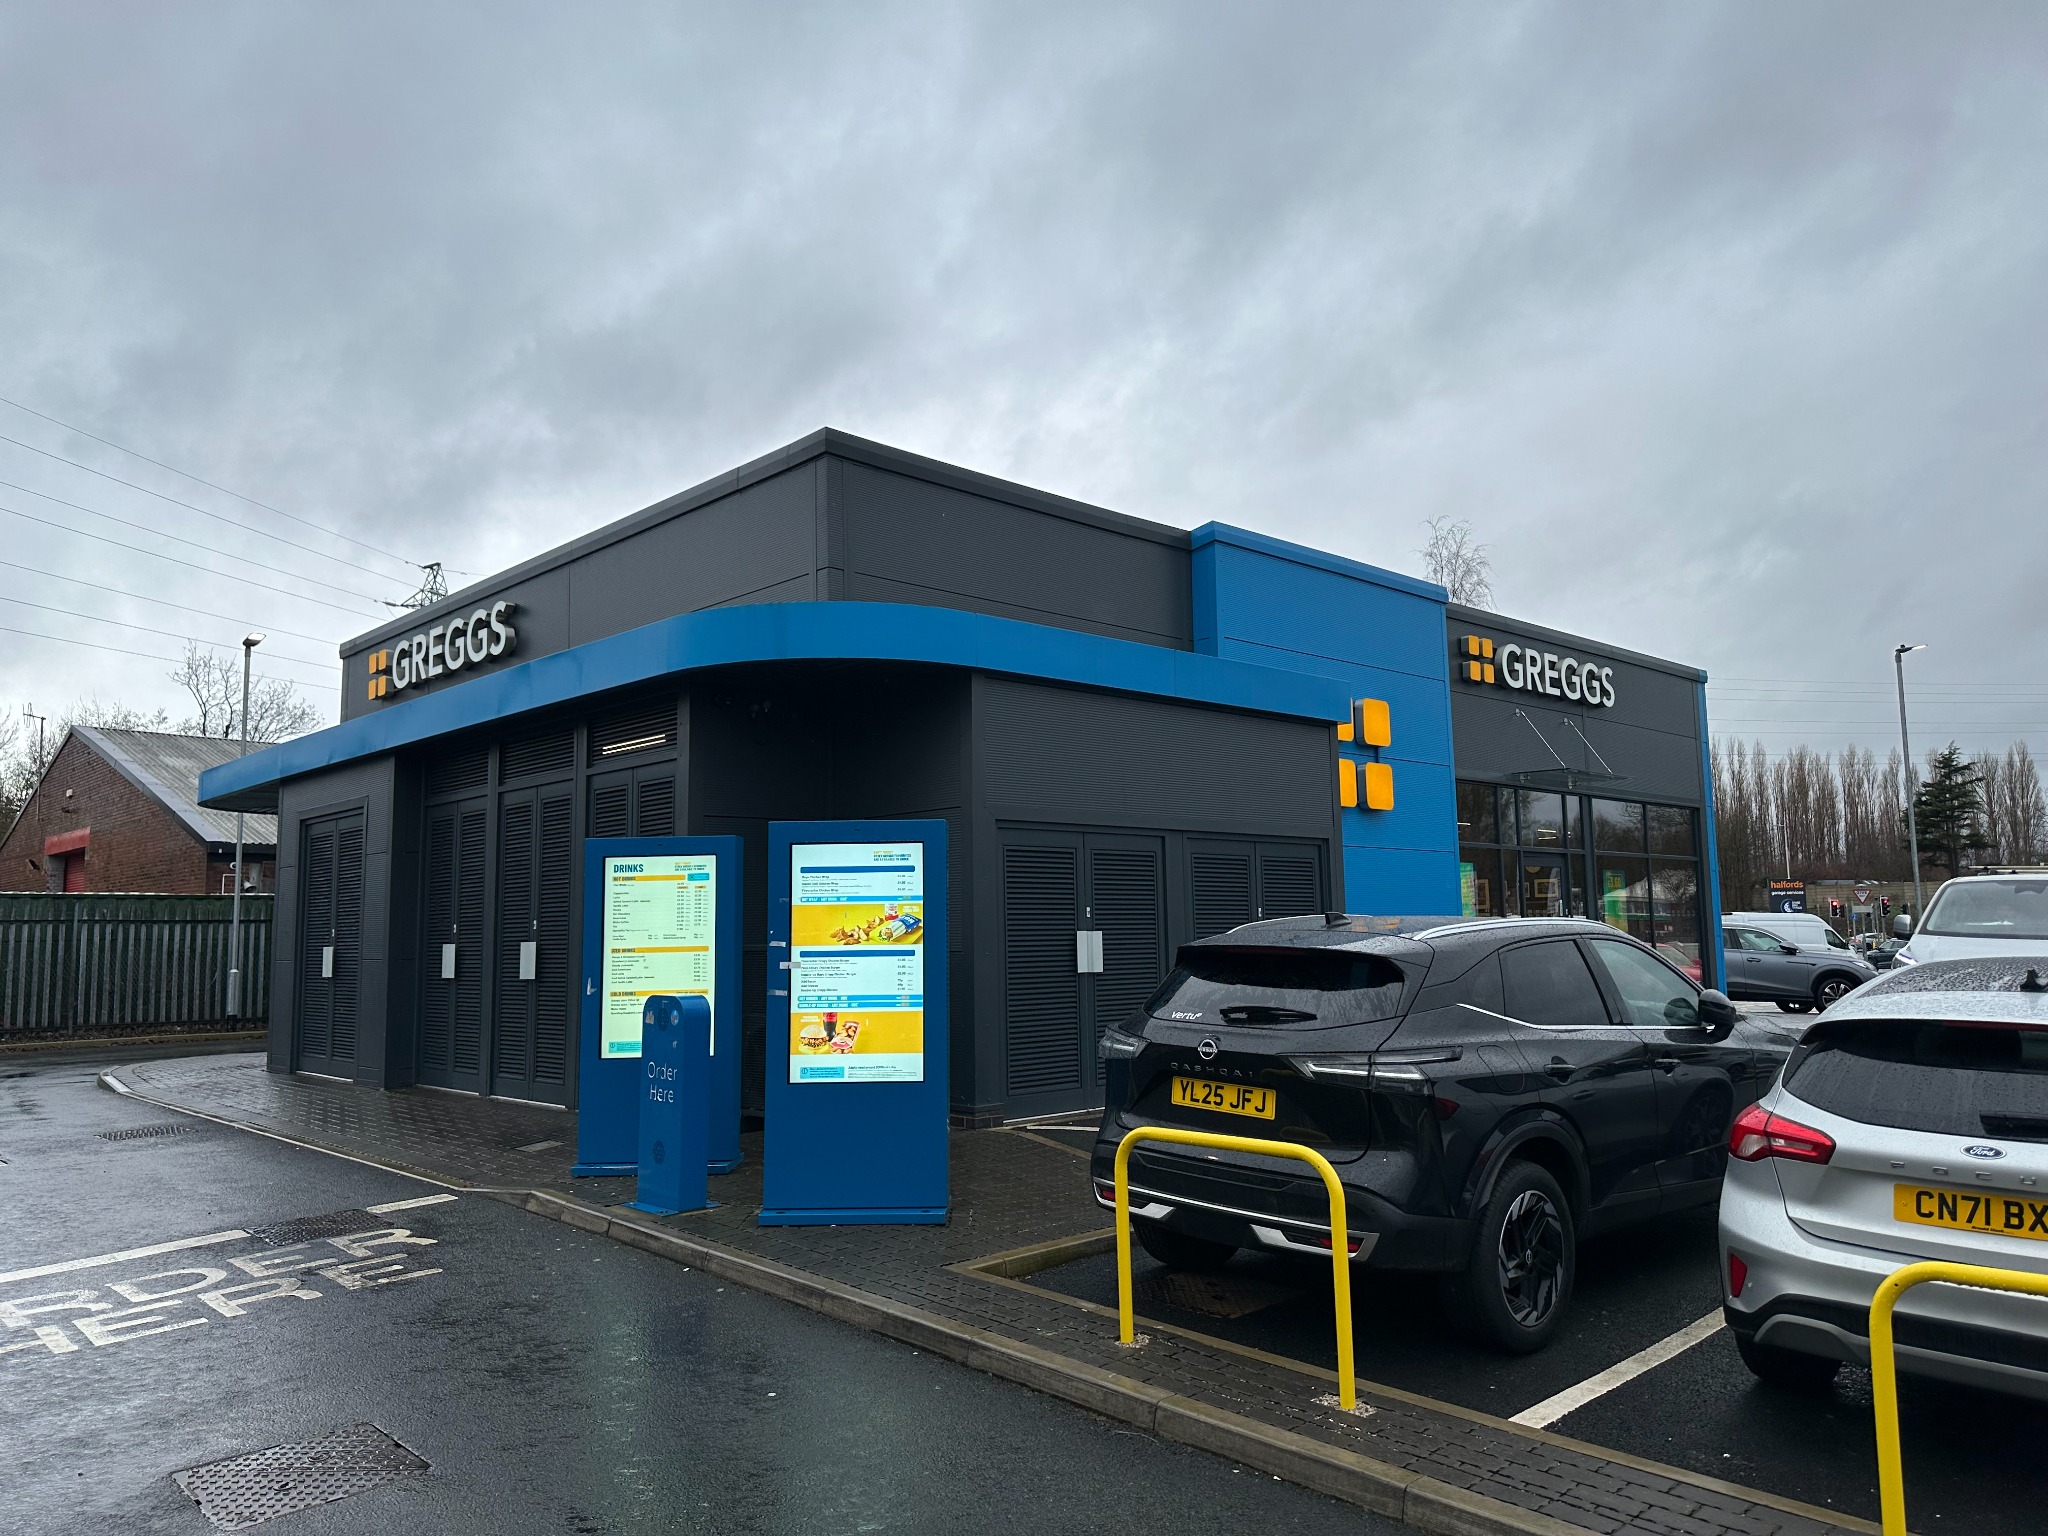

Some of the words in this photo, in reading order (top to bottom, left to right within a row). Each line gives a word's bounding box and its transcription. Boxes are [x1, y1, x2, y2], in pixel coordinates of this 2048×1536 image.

[392, 600, 508, 689] GREGGS
[1501, 643, 1616, 708] GREGGS
[613, 863, 644, 873] DRINKS
[1770, 880, 1804, 889] halfords
[1197, 1046, 1218, 1054] NISSAN
[647, 1061, 678, 1081] Order
[1170, 1062, 1253, 1078] QASHQAI
[649, 1083, 674, 1103] Here
[1180, 1079, 1225, 1107] YL25
[1229, 1087, 1267, 1113] JFJ
[1969, 1146, 1996, 1157] Ford
[1915, 1190, 1991, 1227] CN71
